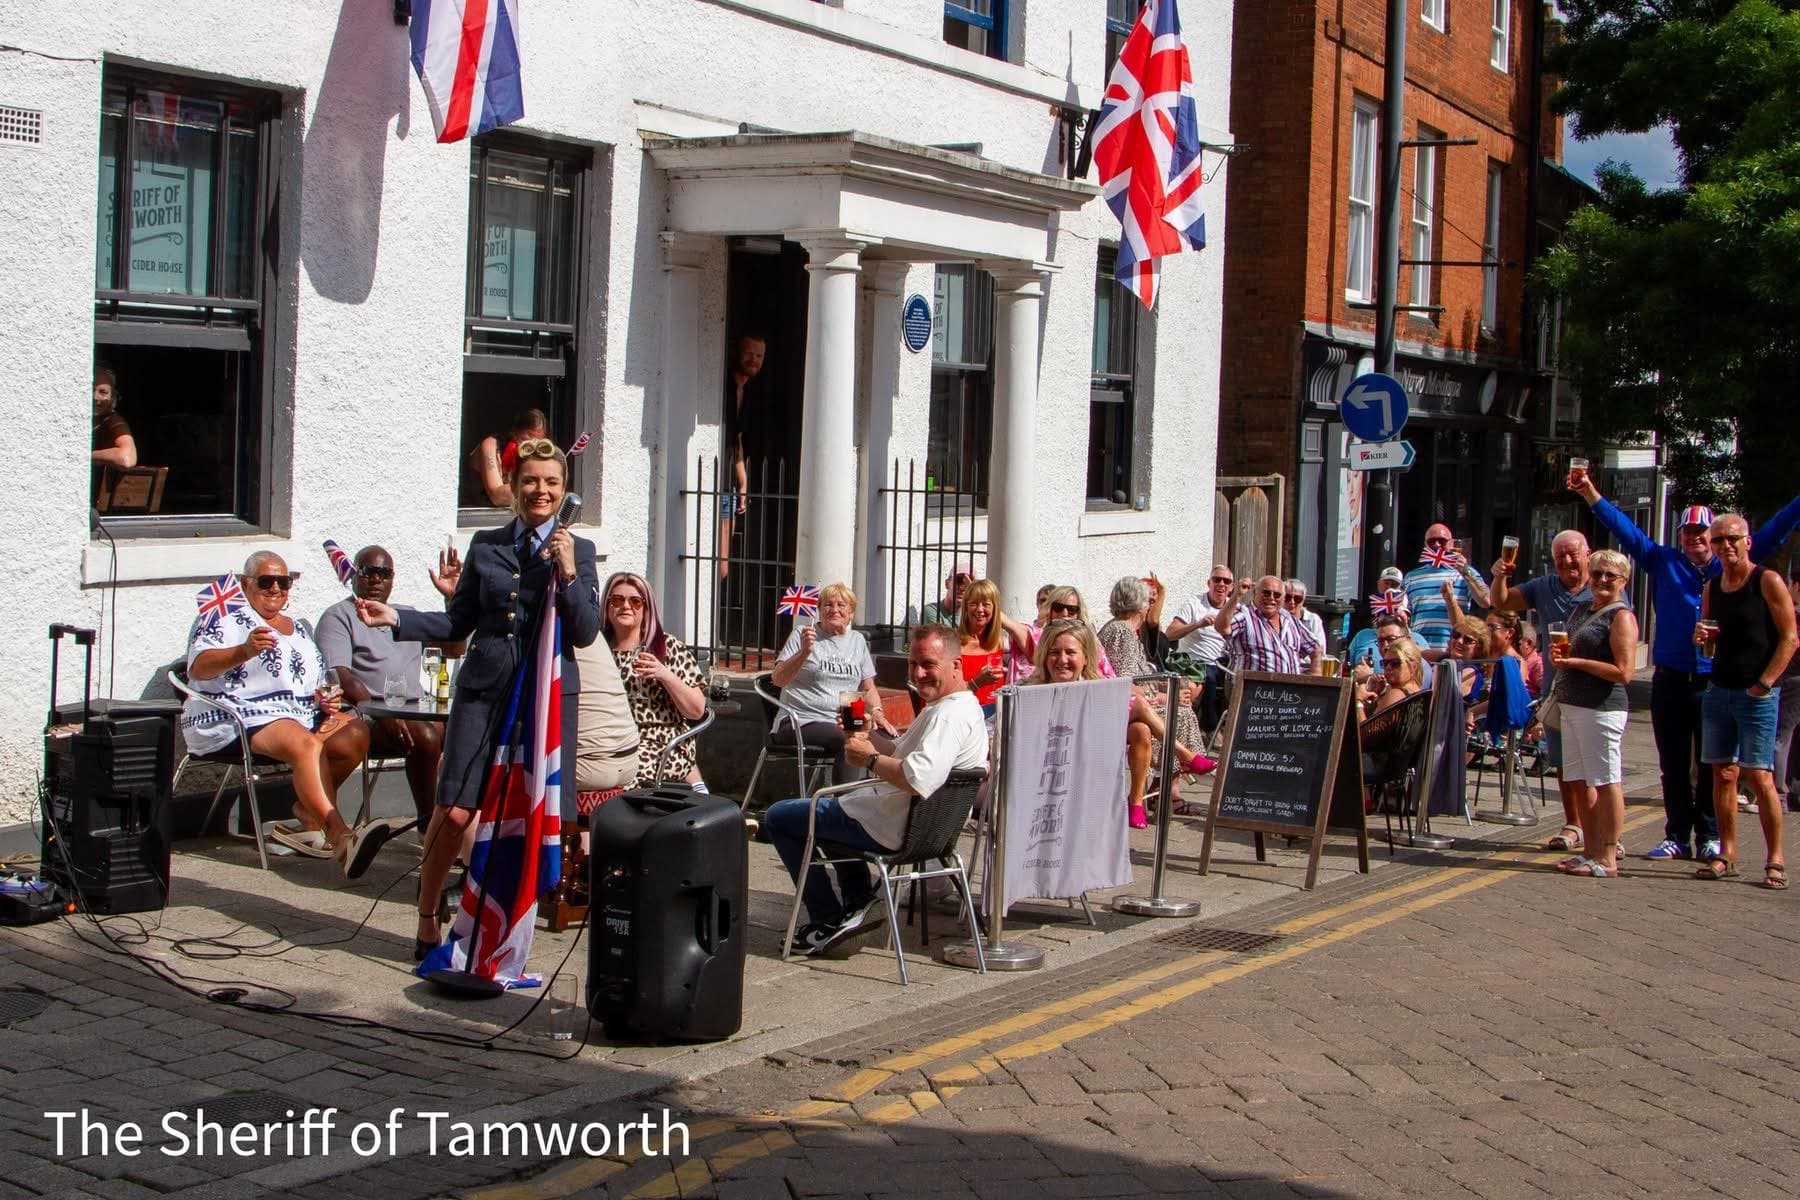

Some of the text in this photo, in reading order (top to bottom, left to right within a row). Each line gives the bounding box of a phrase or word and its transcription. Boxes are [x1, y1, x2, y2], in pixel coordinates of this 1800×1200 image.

[108, 185, 181, 210] SRIFF OF
[132, 259, 184, 274] CIDER HOUSE
[1370, 452, 1388, 460] KIER
[1254, 686, 1302, 704] REAL ALES
[1250, 706, 1274, 715] DAISY
[1237, 750, 1295, 763] DAMN DOG 5%
[1223, 804, 1244, 812] CAMRA
[606, 917, 630, 929] DRIVE
